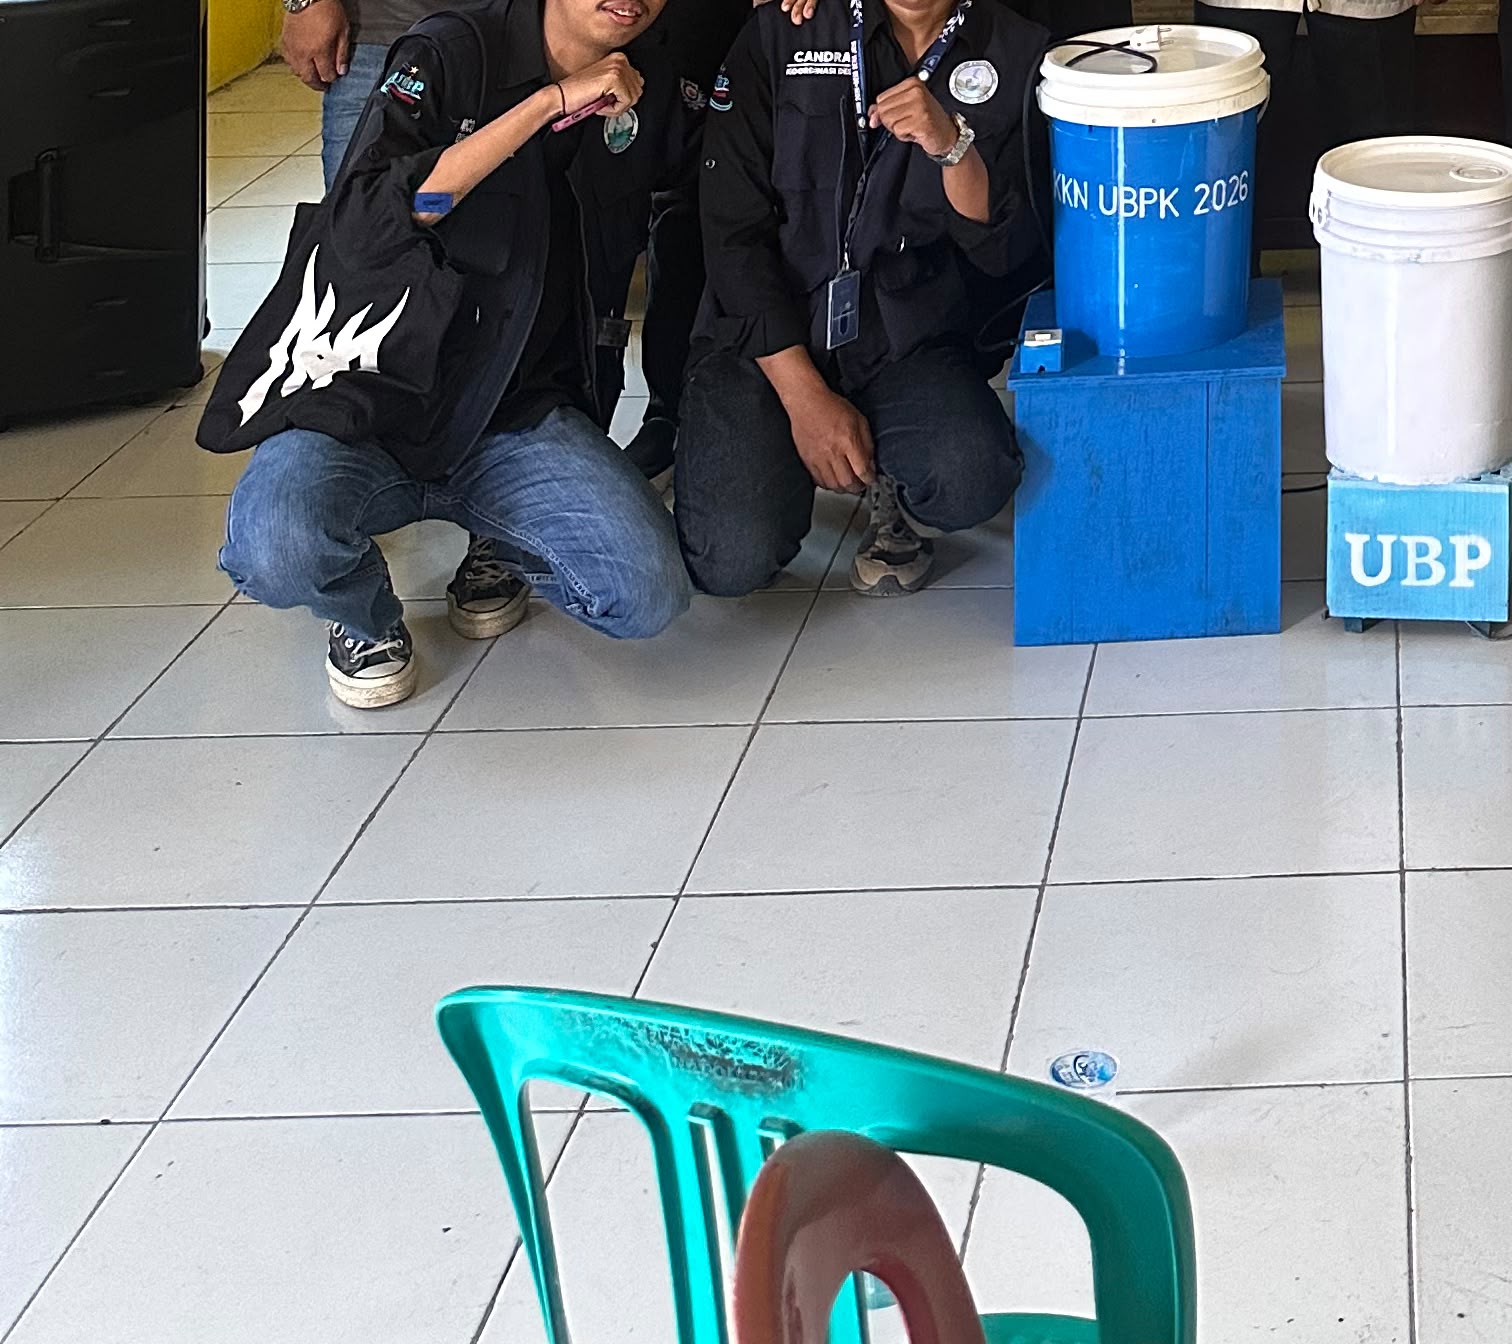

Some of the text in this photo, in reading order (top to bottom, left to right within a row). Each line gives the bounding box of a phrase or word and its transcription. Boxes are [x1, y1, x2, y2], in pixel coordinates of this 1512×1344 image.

[793, 50, 852, 63] CANDRA
[1053, 167, 1249, 220] KKN UBPK 2026
[1344, 532, 1492, 588] UBP
